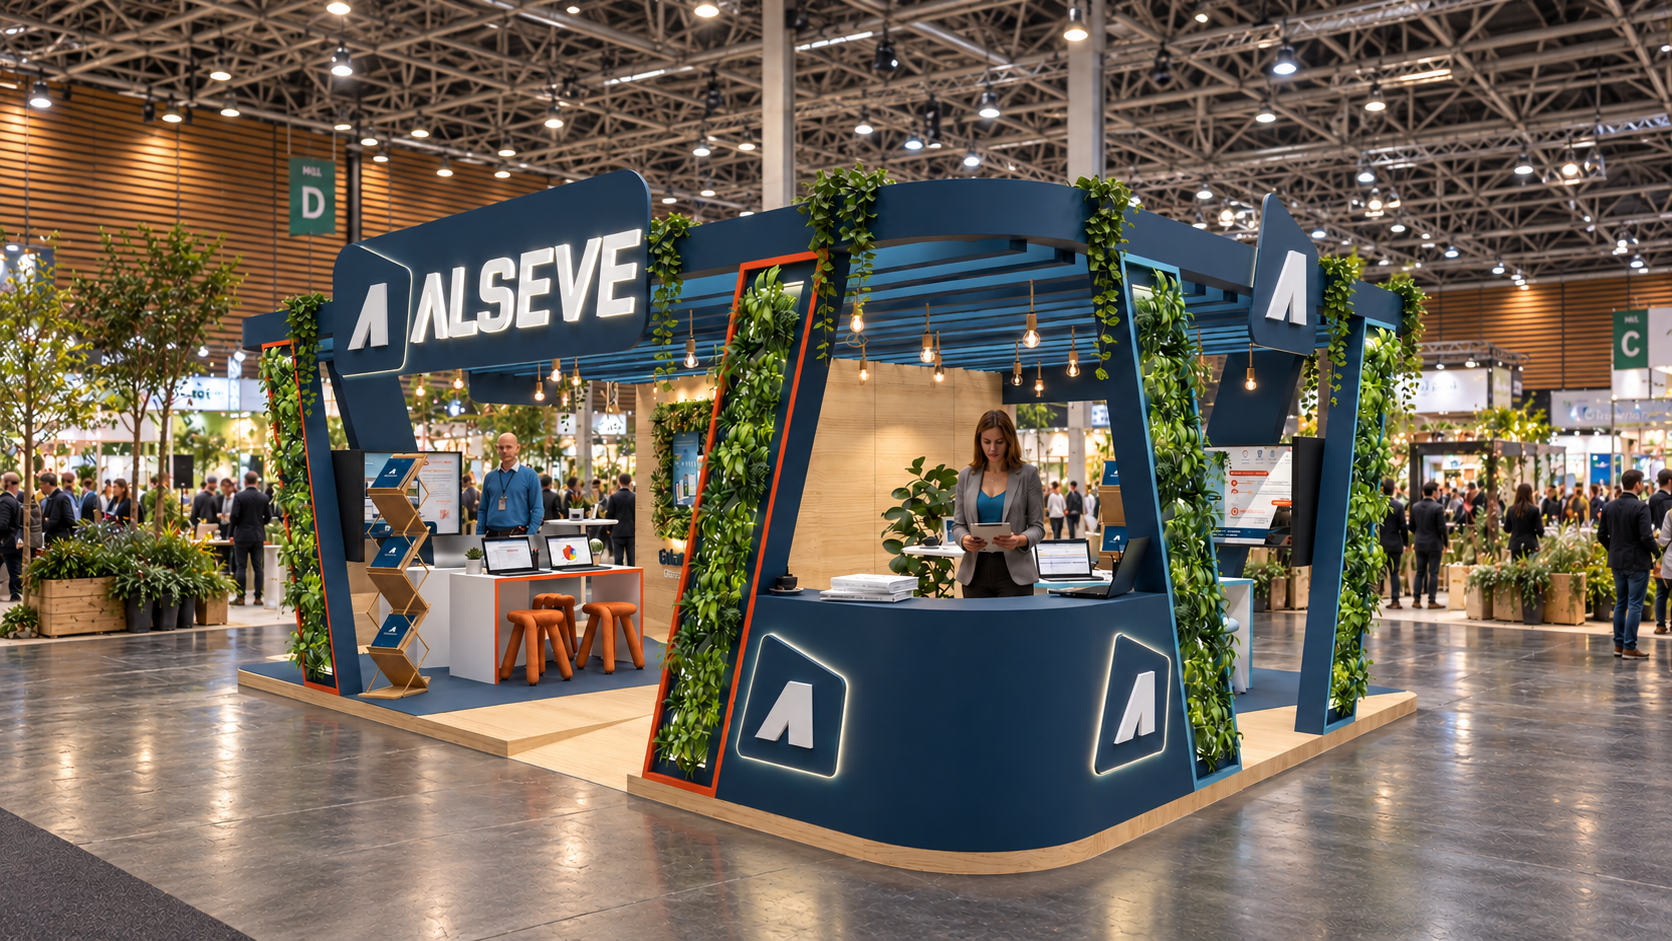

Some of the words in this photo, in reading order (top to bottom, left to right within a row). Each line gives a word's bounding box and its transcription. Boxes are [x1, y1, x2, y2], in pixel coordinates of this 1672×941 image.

[302, 185, 325, 219] D
[410, 228, 642, 344] ALSEVE
[1621, 330, 1640, 357] C
